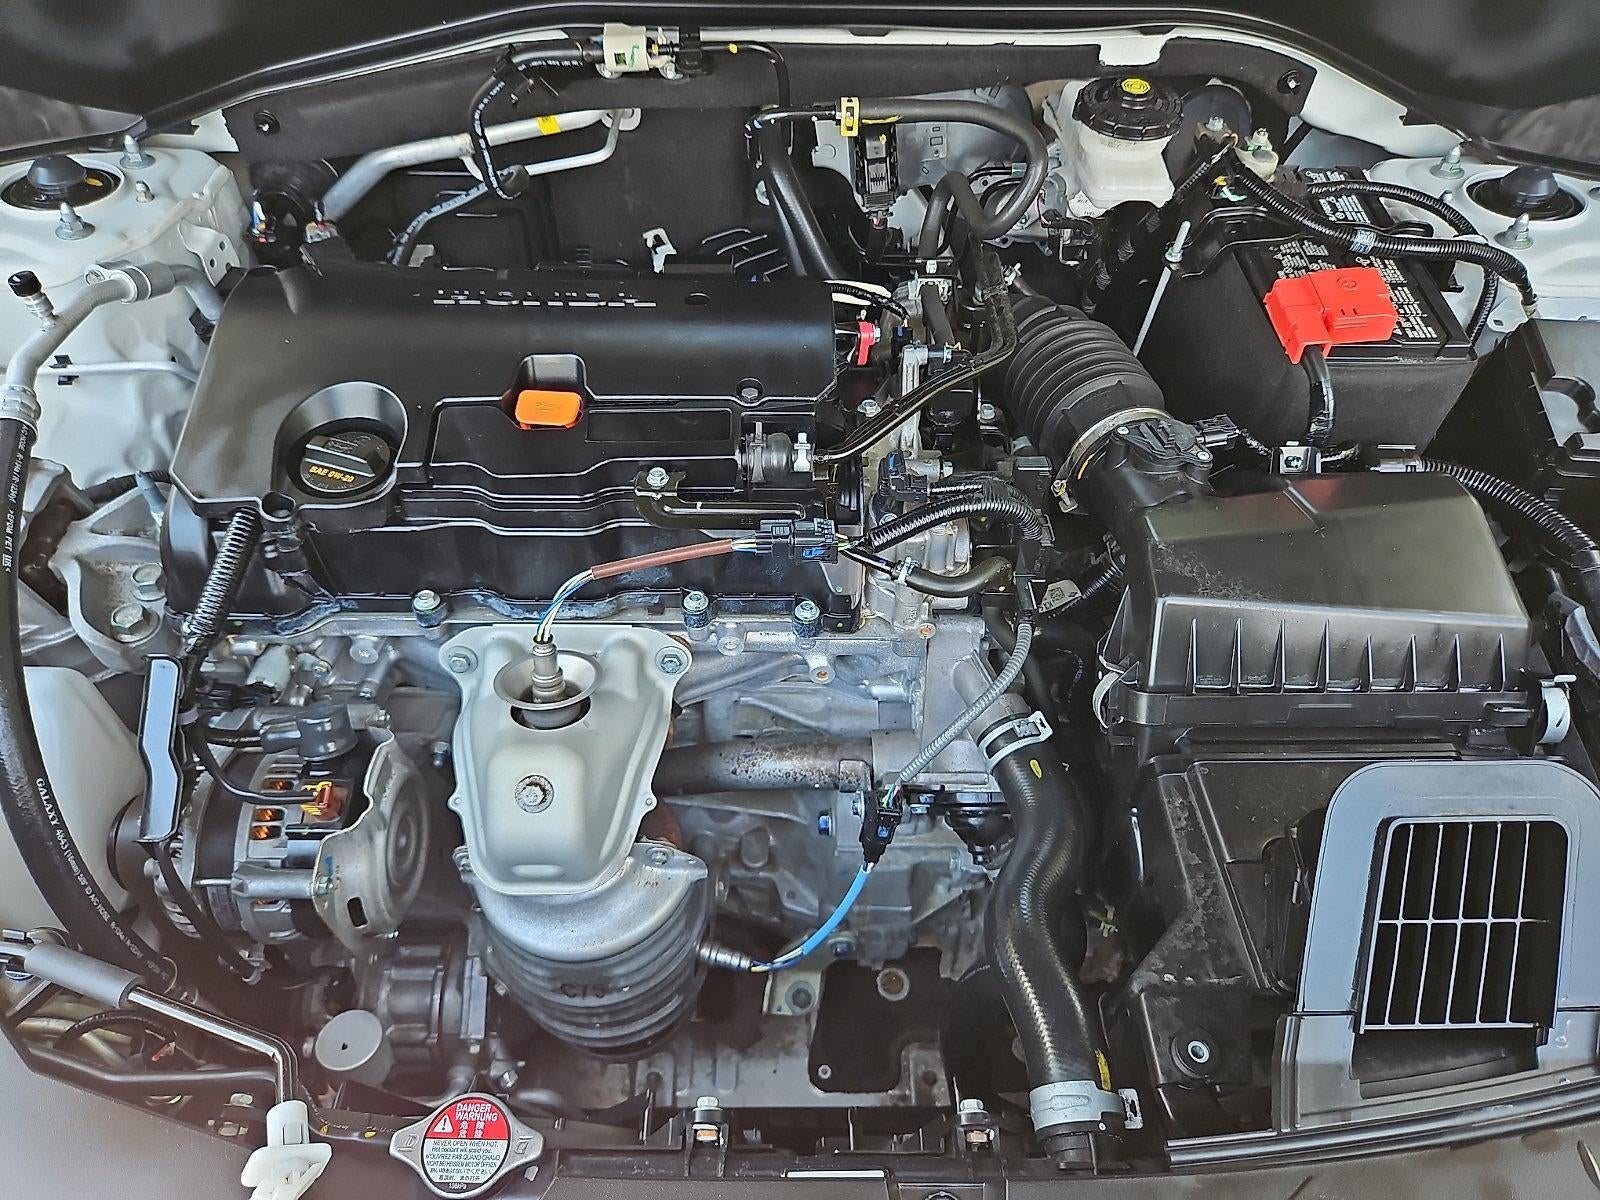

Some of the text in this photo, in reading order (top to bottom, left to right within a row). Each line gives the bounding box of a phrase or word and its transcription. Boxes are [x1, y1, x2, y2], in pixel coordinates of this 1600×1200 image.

[309, 465, 355, 483] SAE 0W-20
[36, 777, 60, 825] GALAXY
[56, 829, 69, 850] 4843
[456, 1103, 492, 1112] DANGER
[455, 1111, 498, 1121] WARNUNG
